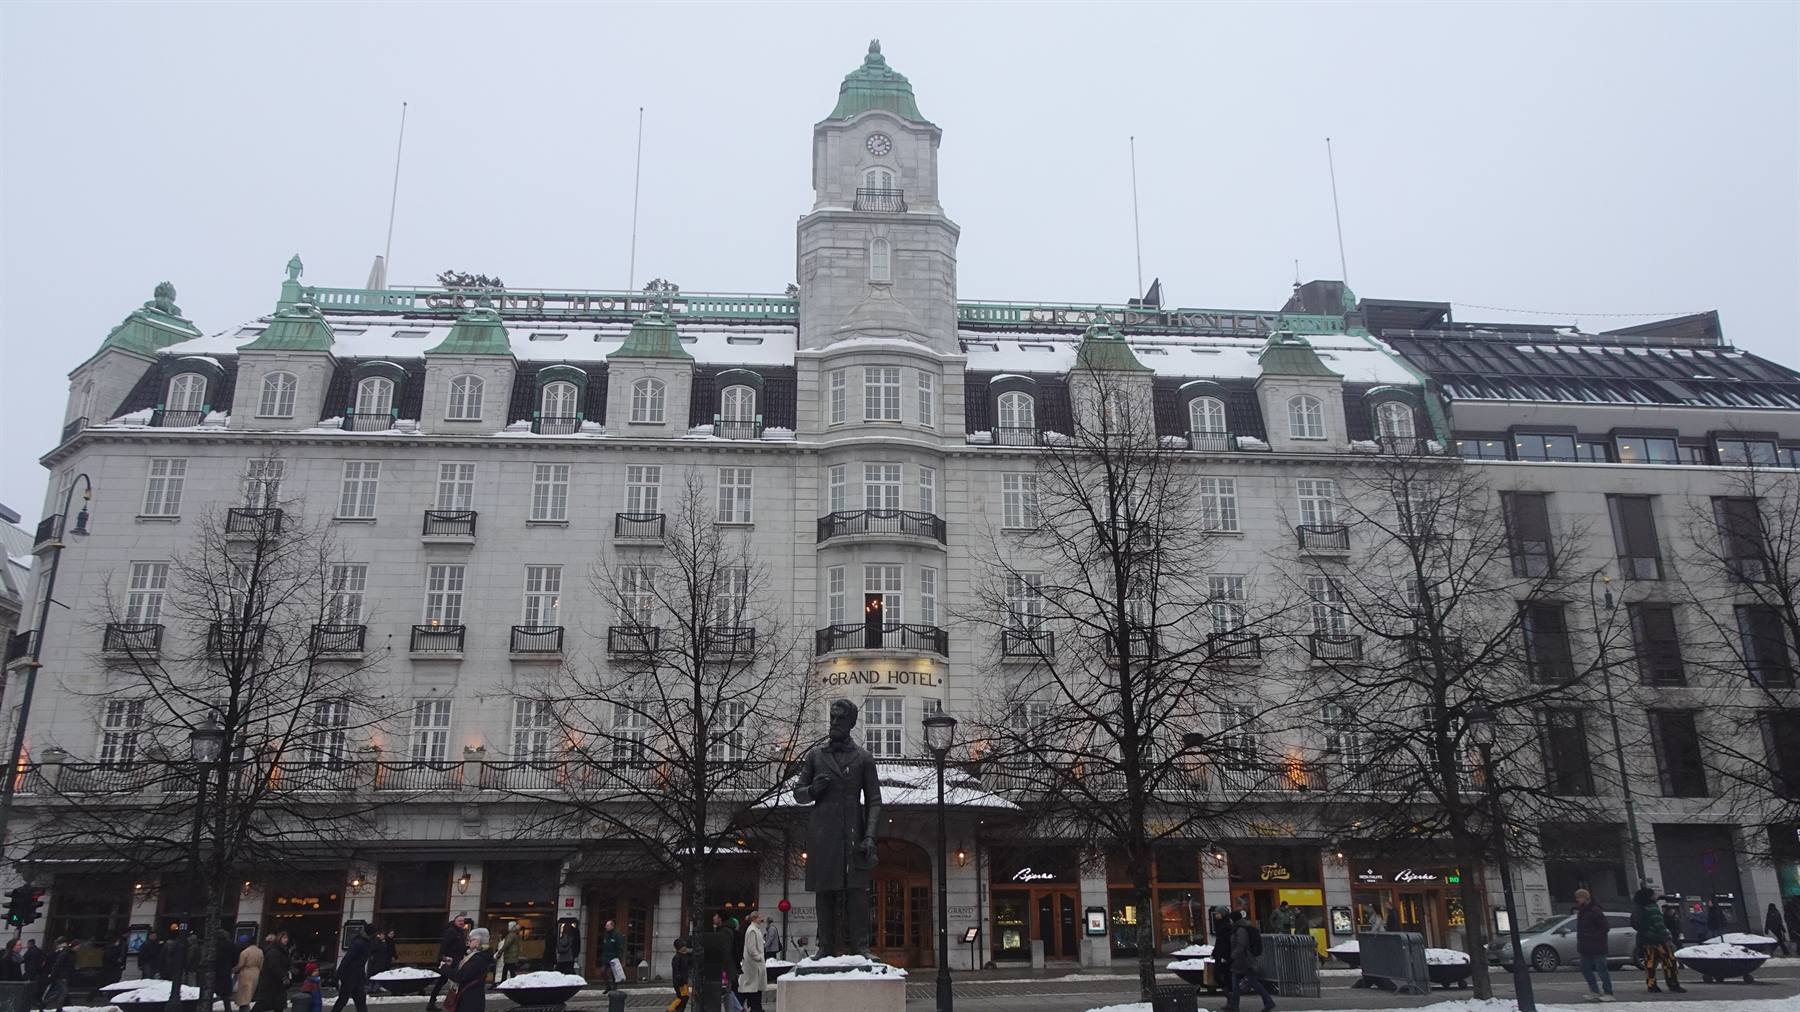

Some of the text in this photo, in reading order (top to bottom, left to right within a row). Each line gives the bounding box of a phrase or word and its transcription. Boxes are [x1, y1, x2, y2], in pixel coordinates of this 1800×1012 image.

[1029, 307, 1141, 325] GRAND
[828, 670, 937, 687] GRAND HOTEL
[1394, 868, 1437, 883] Bjerke
[947, 906, 974, 914] GRAND
